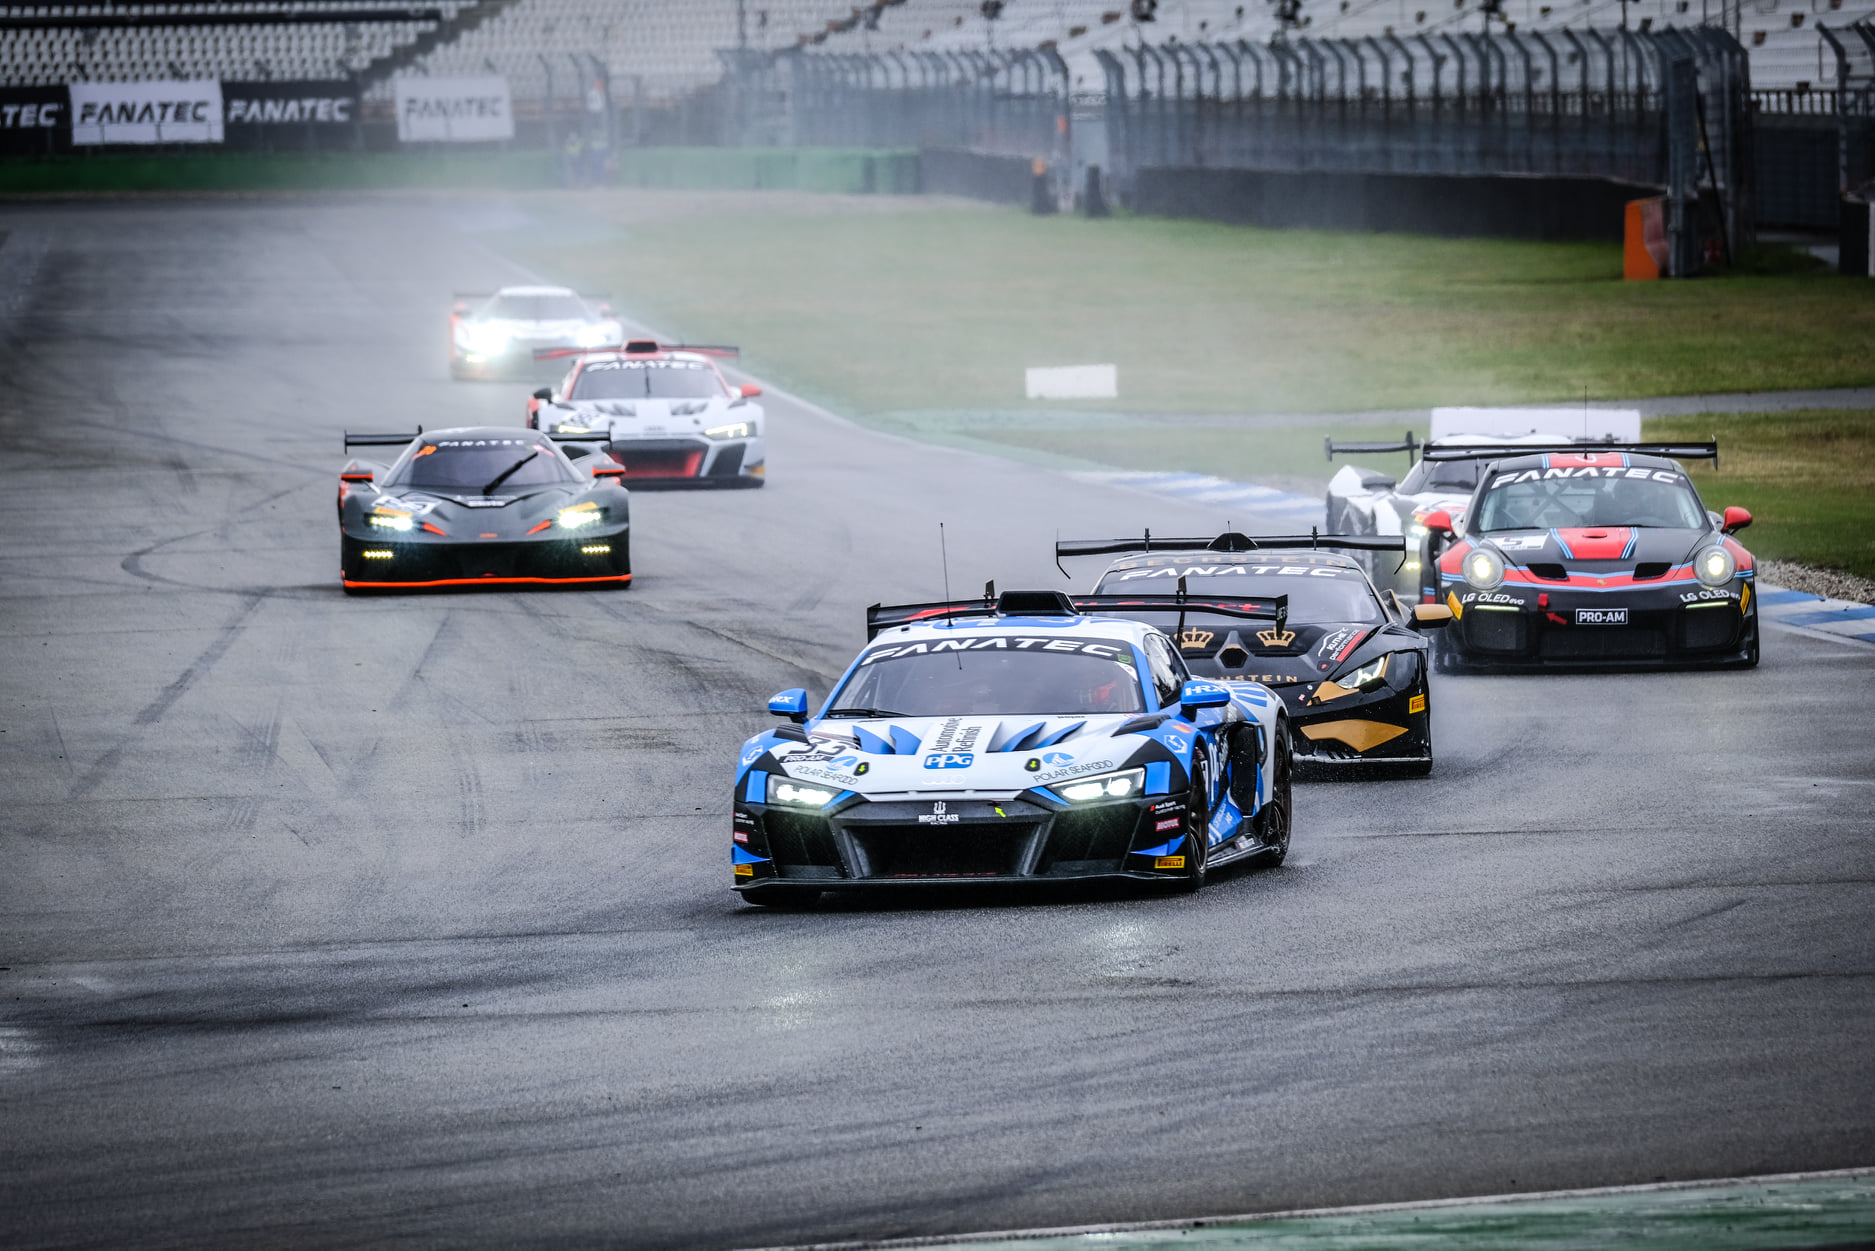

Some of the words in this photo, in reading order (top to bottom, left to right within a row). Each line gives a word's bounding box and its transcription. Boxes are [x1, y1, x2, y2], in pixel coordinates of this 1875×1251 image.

[0, 103, 63, 128] TEC
[80, 100, 211, 124] FANATEC
[228, 97, 352, 123] FANATEC
[405, 96, 503, 119] FANATEC
[587, 360, 704, 372] FANATEC
[438, 439, 525, 447] FANATEC
[1490, 466, 1682, 489] FANATEC
[1119, 566, 1338, 581] FANATEC
[1461, 592, 1476, 604] LG
[1477, 592, 1510, 603] OLED
[1680, 592, 1698, 603] LG
[1699, 589, 1730, 600] OLED
[1578, 611, 1626, 623] PRO-AM
[860, 637, 1122, 666] FANATEC
[952, 726, 982, 752] Refinish
[793, 764, 821, 778] POLAR
[1033, 769, 1069, 783] POLAR
[1069, 759, 1114, 775] SEAFOOD
[937, 814, 959, 822] CLASS
